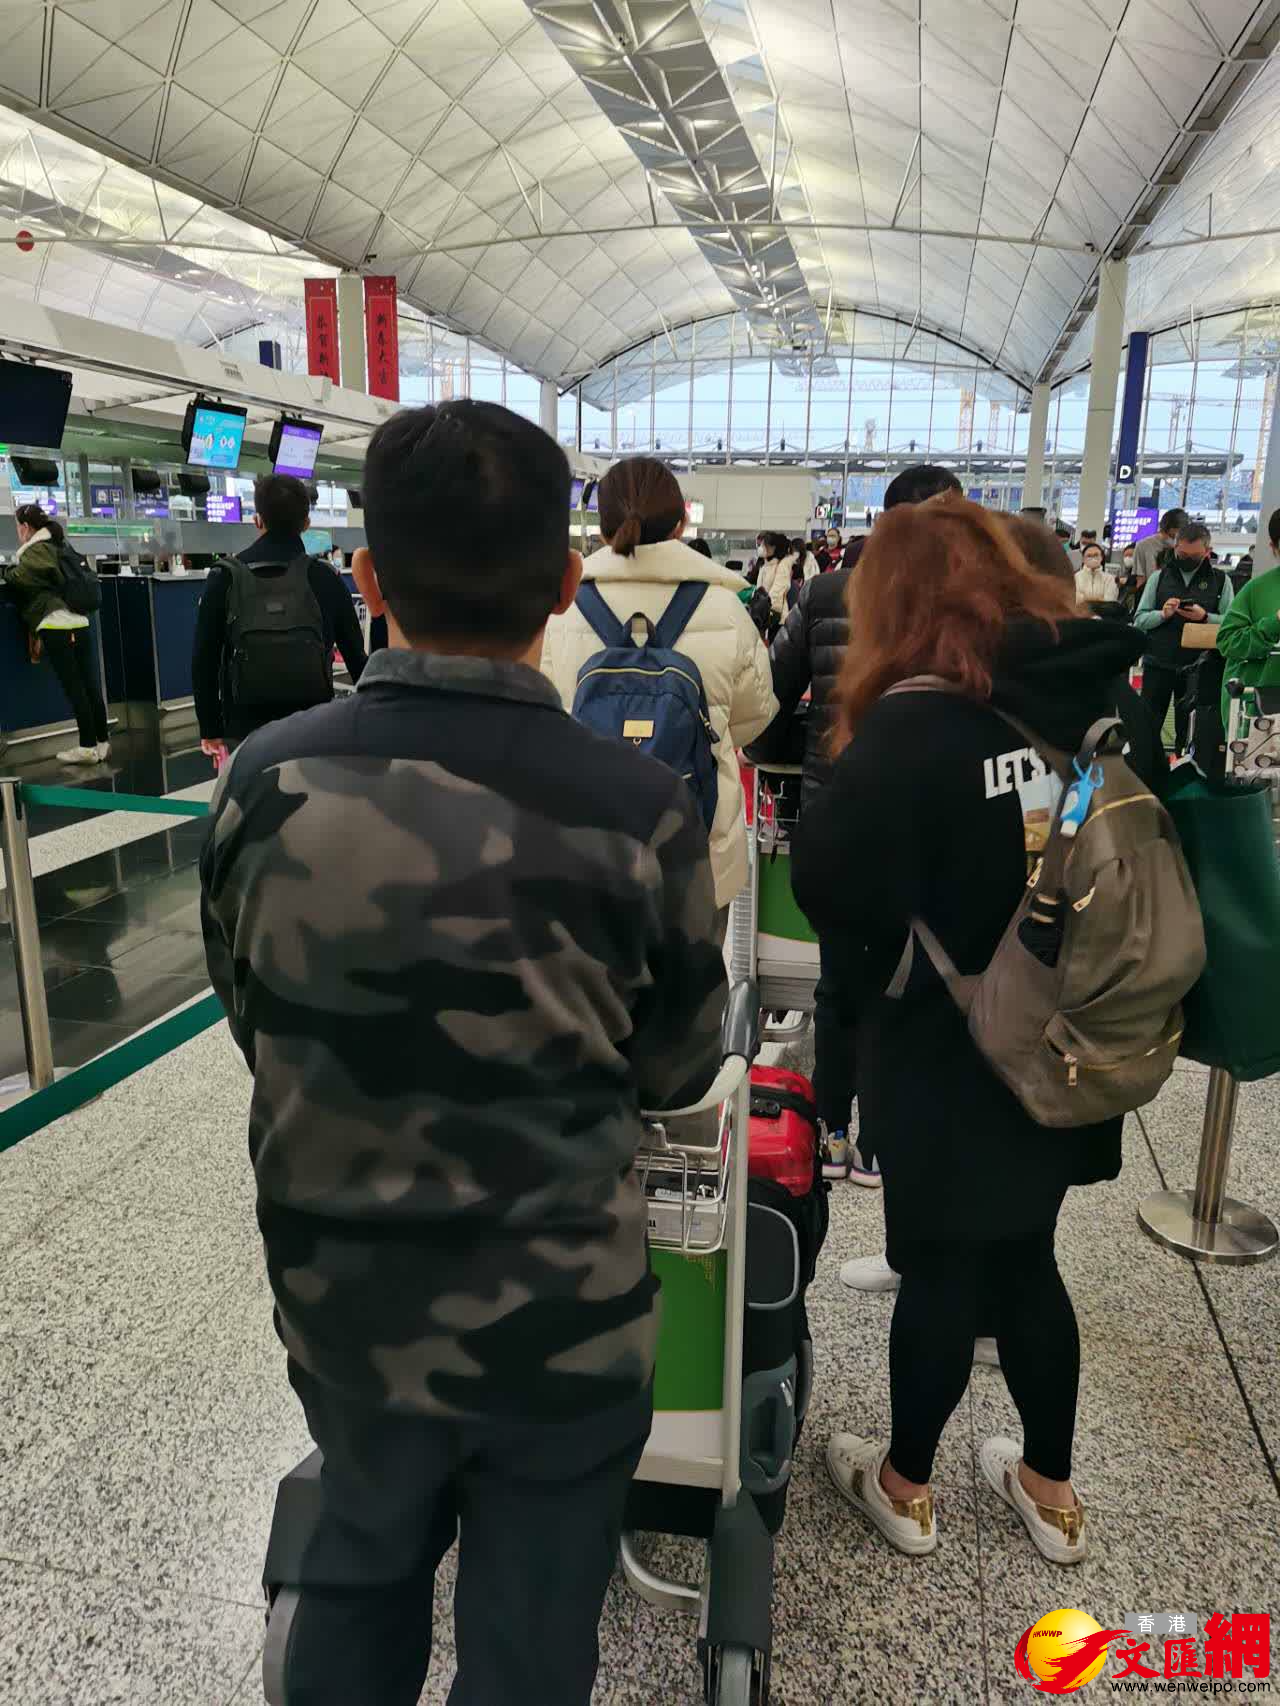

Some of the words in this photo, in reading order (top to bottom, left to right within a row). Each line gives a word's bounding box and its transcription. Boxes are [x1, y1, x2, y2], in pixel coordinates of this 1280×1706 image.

[315, 313, 329, 376] 恭賀新
[1119, 464, 1132, 480] D
